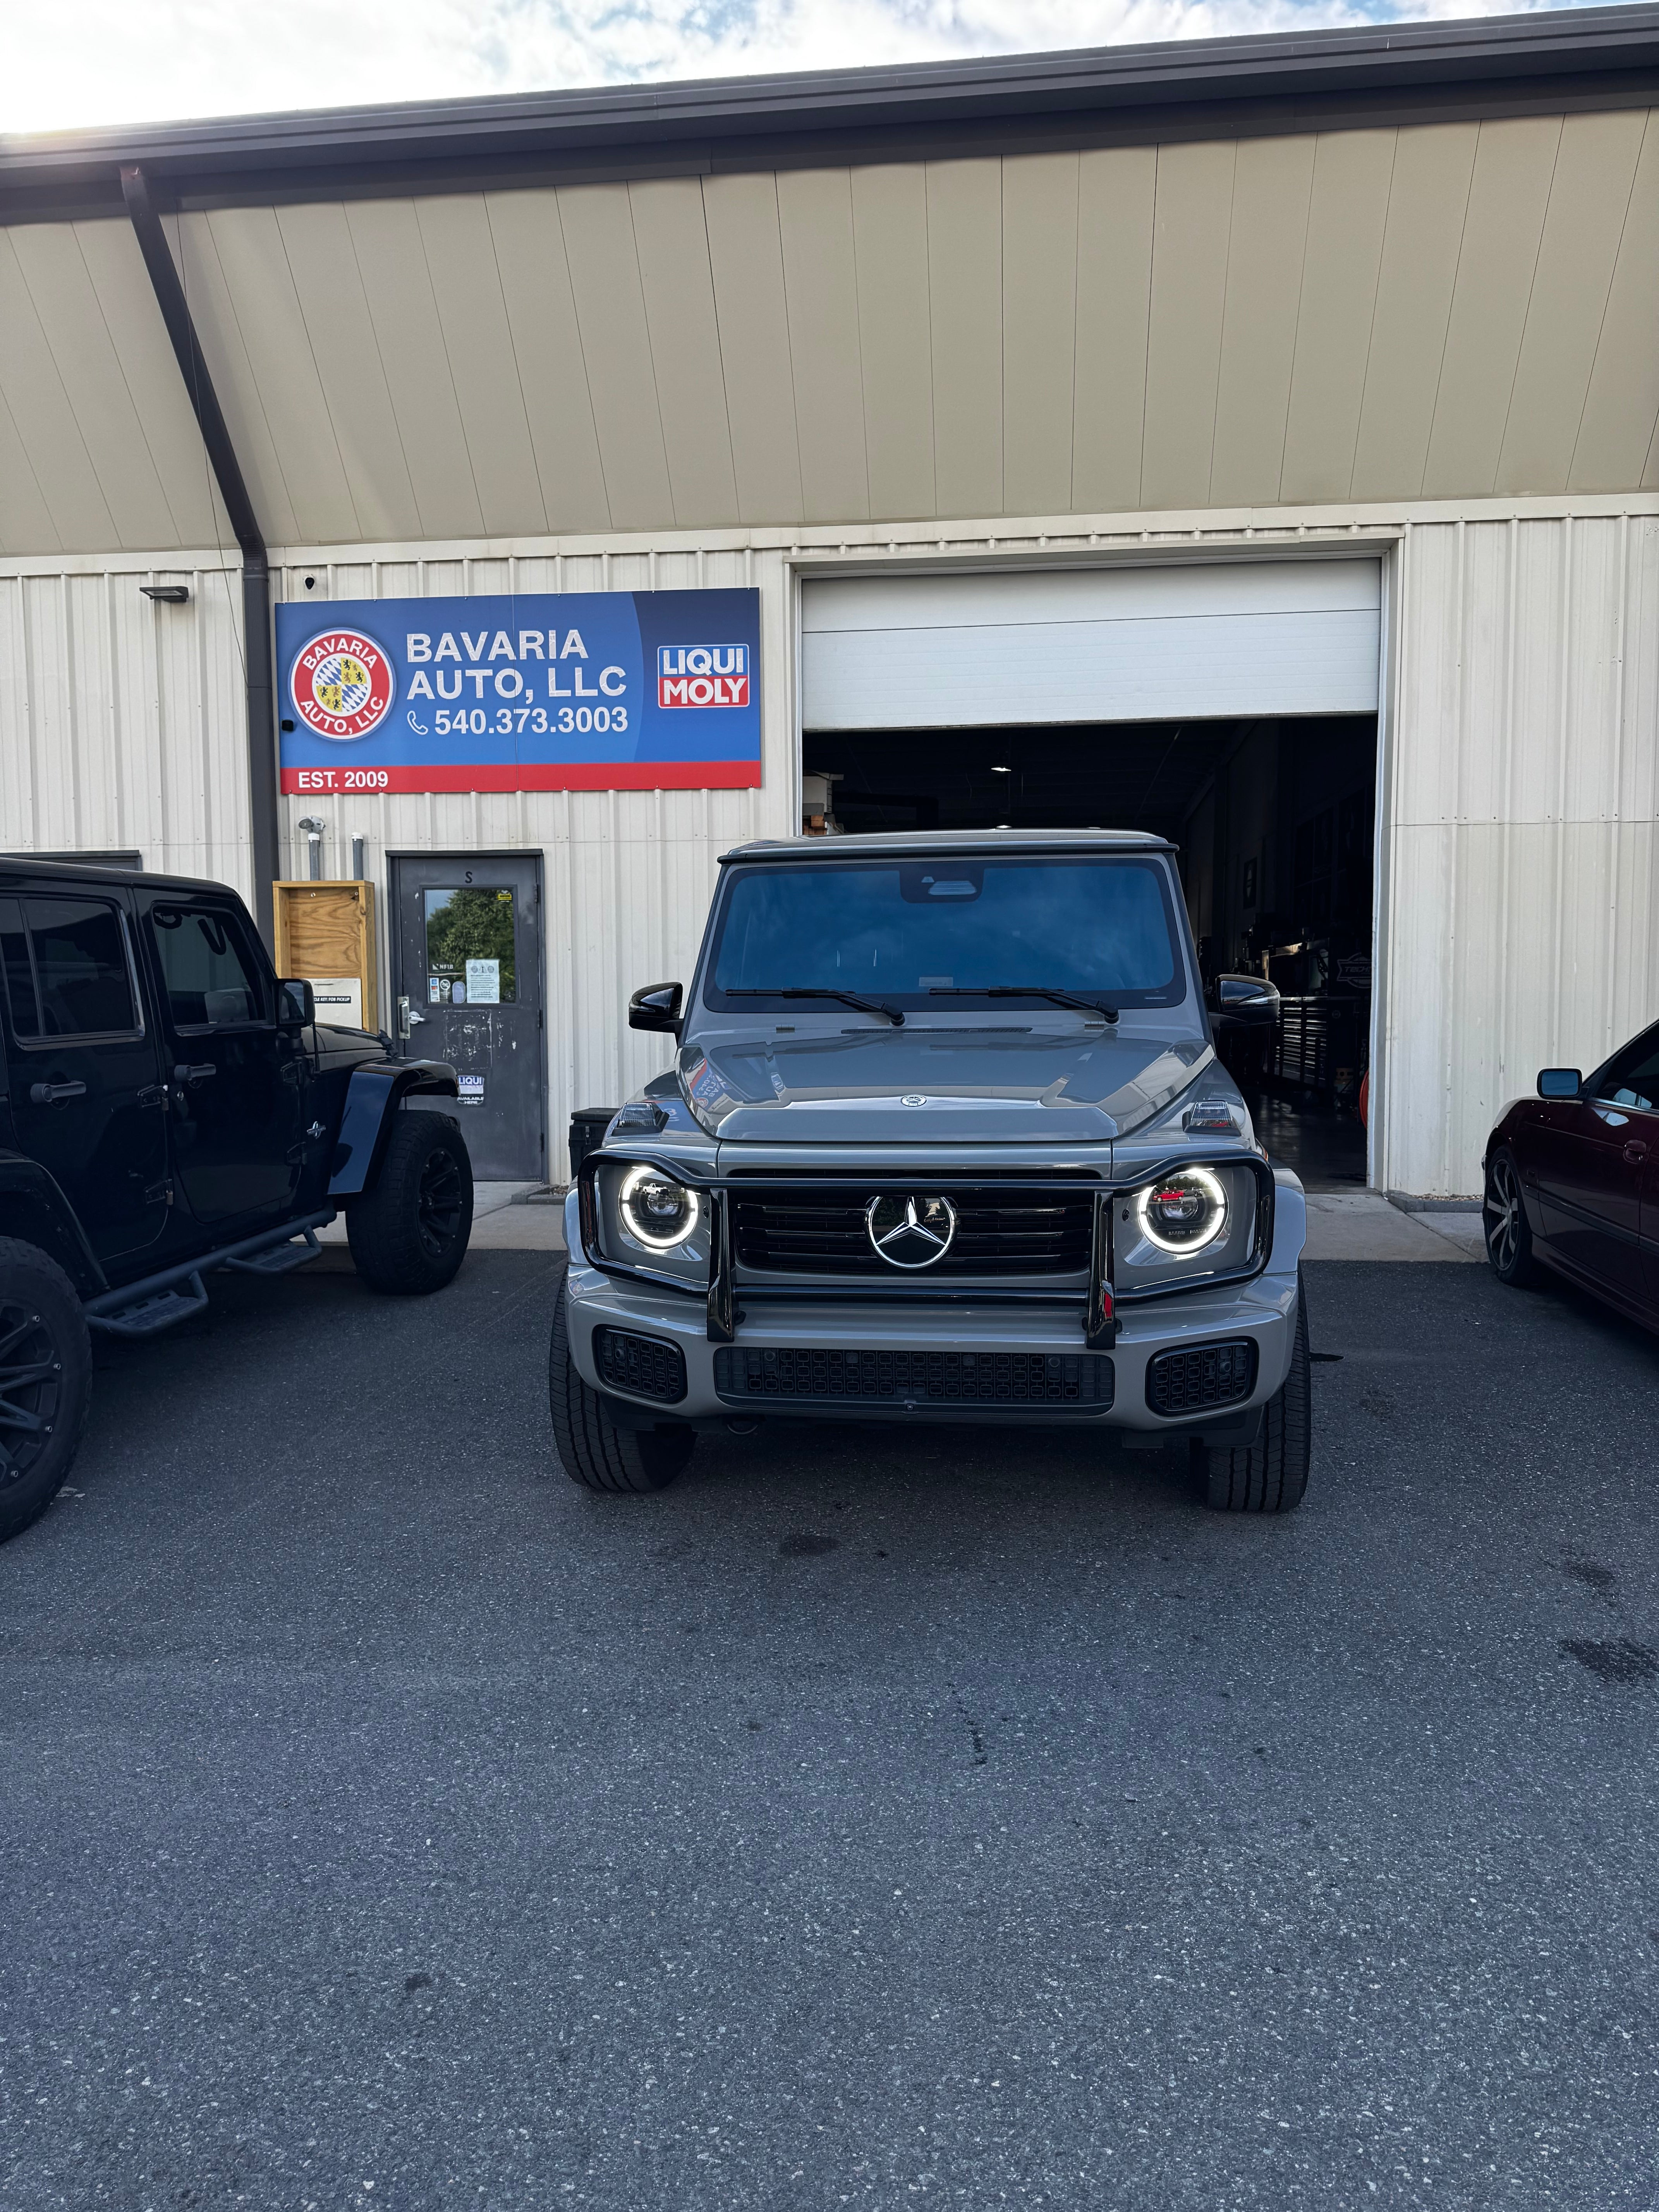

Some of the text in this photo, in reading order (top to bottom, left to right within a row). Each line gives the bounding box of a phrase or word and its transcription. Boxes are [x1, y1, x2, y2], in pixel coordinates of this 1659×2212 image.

[302, 638, 378, 670] BAVARIA
[407, 630, 589, 663] BAVARIA
[663, 648, 744, 676] LIQUI
[407, 666, 627, 704] AUTO, LLC
[664, 678, 747, 704] MOLY
[300, 697, 383, 735] AUTO, LLC
[434, 707, 628, 735] 540.373.3003
[299, 771, 388, 788] EST. 2009
[465, 871, 472, 884] S
